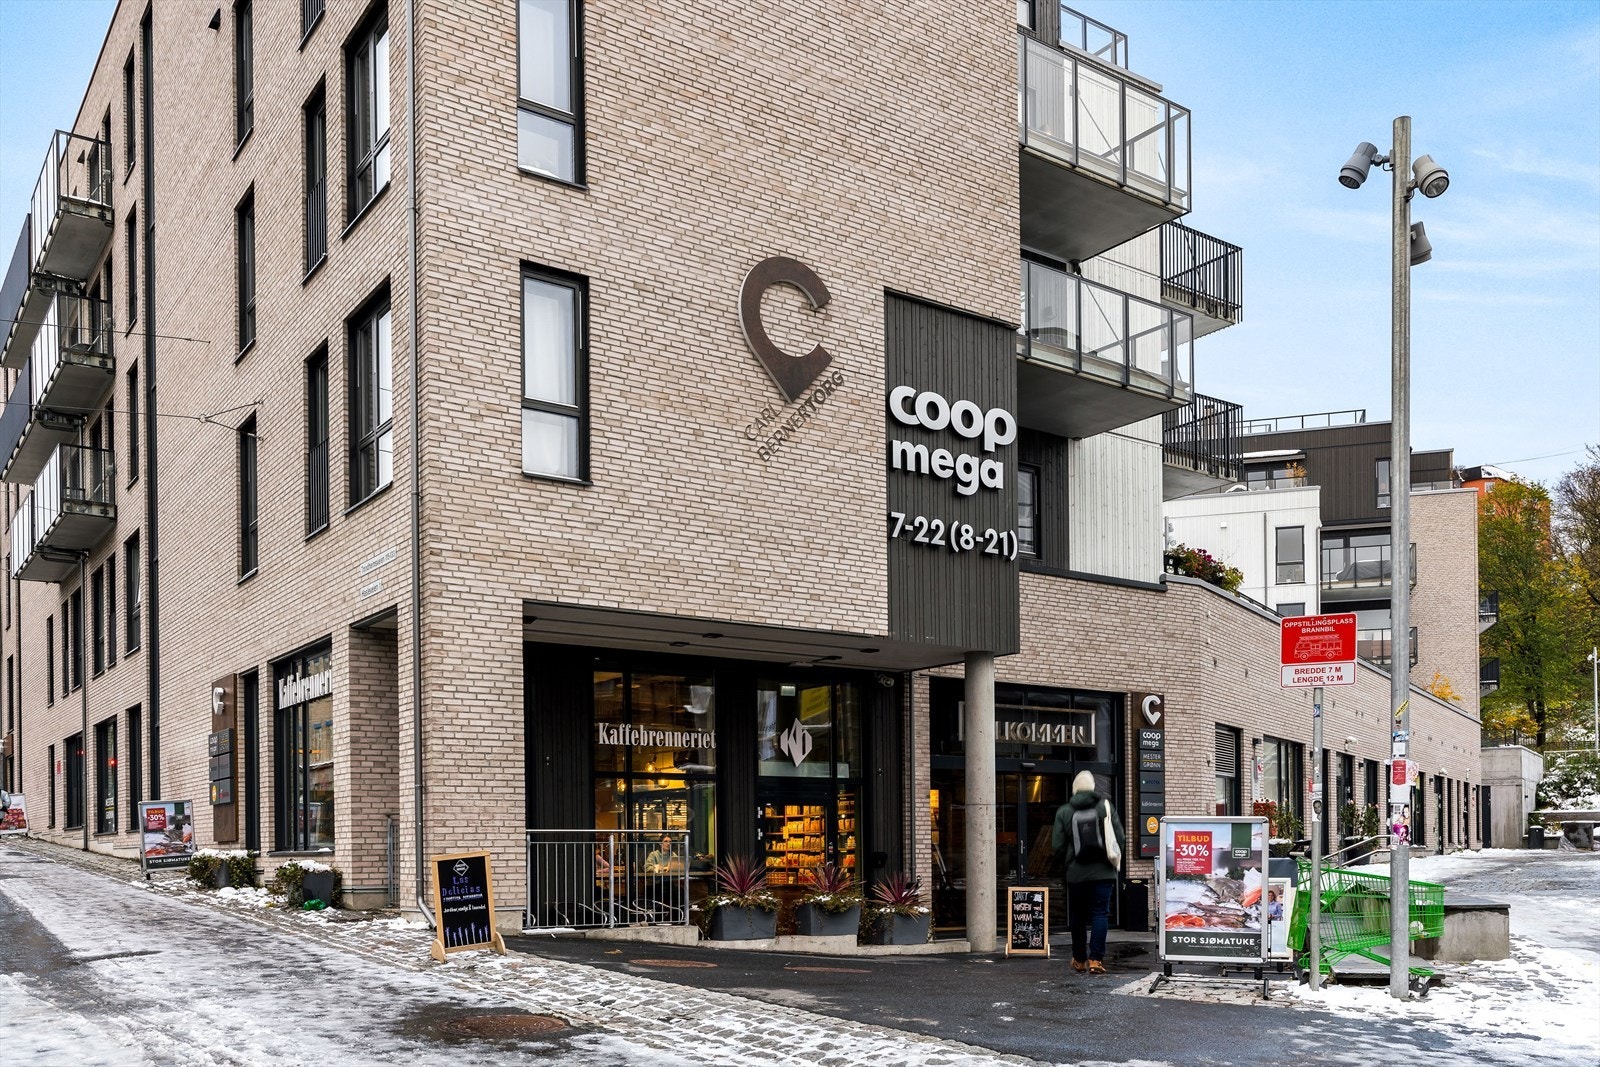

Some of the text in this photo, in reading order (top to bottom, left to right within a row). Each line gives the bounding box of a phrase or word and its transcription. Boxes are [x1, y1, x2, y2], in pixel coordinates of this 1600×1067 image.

[744, 402, 782, 441] CARL
[757, 370, 844, 462] BERNERTORG
[889, 385, 1018, 453] coop
[892, 438, 1004, 496] mega
[890, 511, 1018, 562] 7-22 (8-21)
[1284, 617, 1354, 628] OPPSTILLINGSPLASS
[1301, 626, 1336, 634] BRANNBIL
[1294, 667, 1326, 675] BREDDE
[279, 661, 332, 710] Kaffebrenneri
[1292, 675, 1324, 684] LENGDE
[598, 722, 718, 749] Kaffebrenneriet
[995, 721, 1086, 744] LKOMMEN
[1142, 731, 1162, 740] coop
[1142, 740, 1160, 748] mega
[1175, 844, 1210, 857] -30%
[441, 885, 481, 897] Delicias
[1172, 936, 1255, 946] STOR SJØMATUKE
